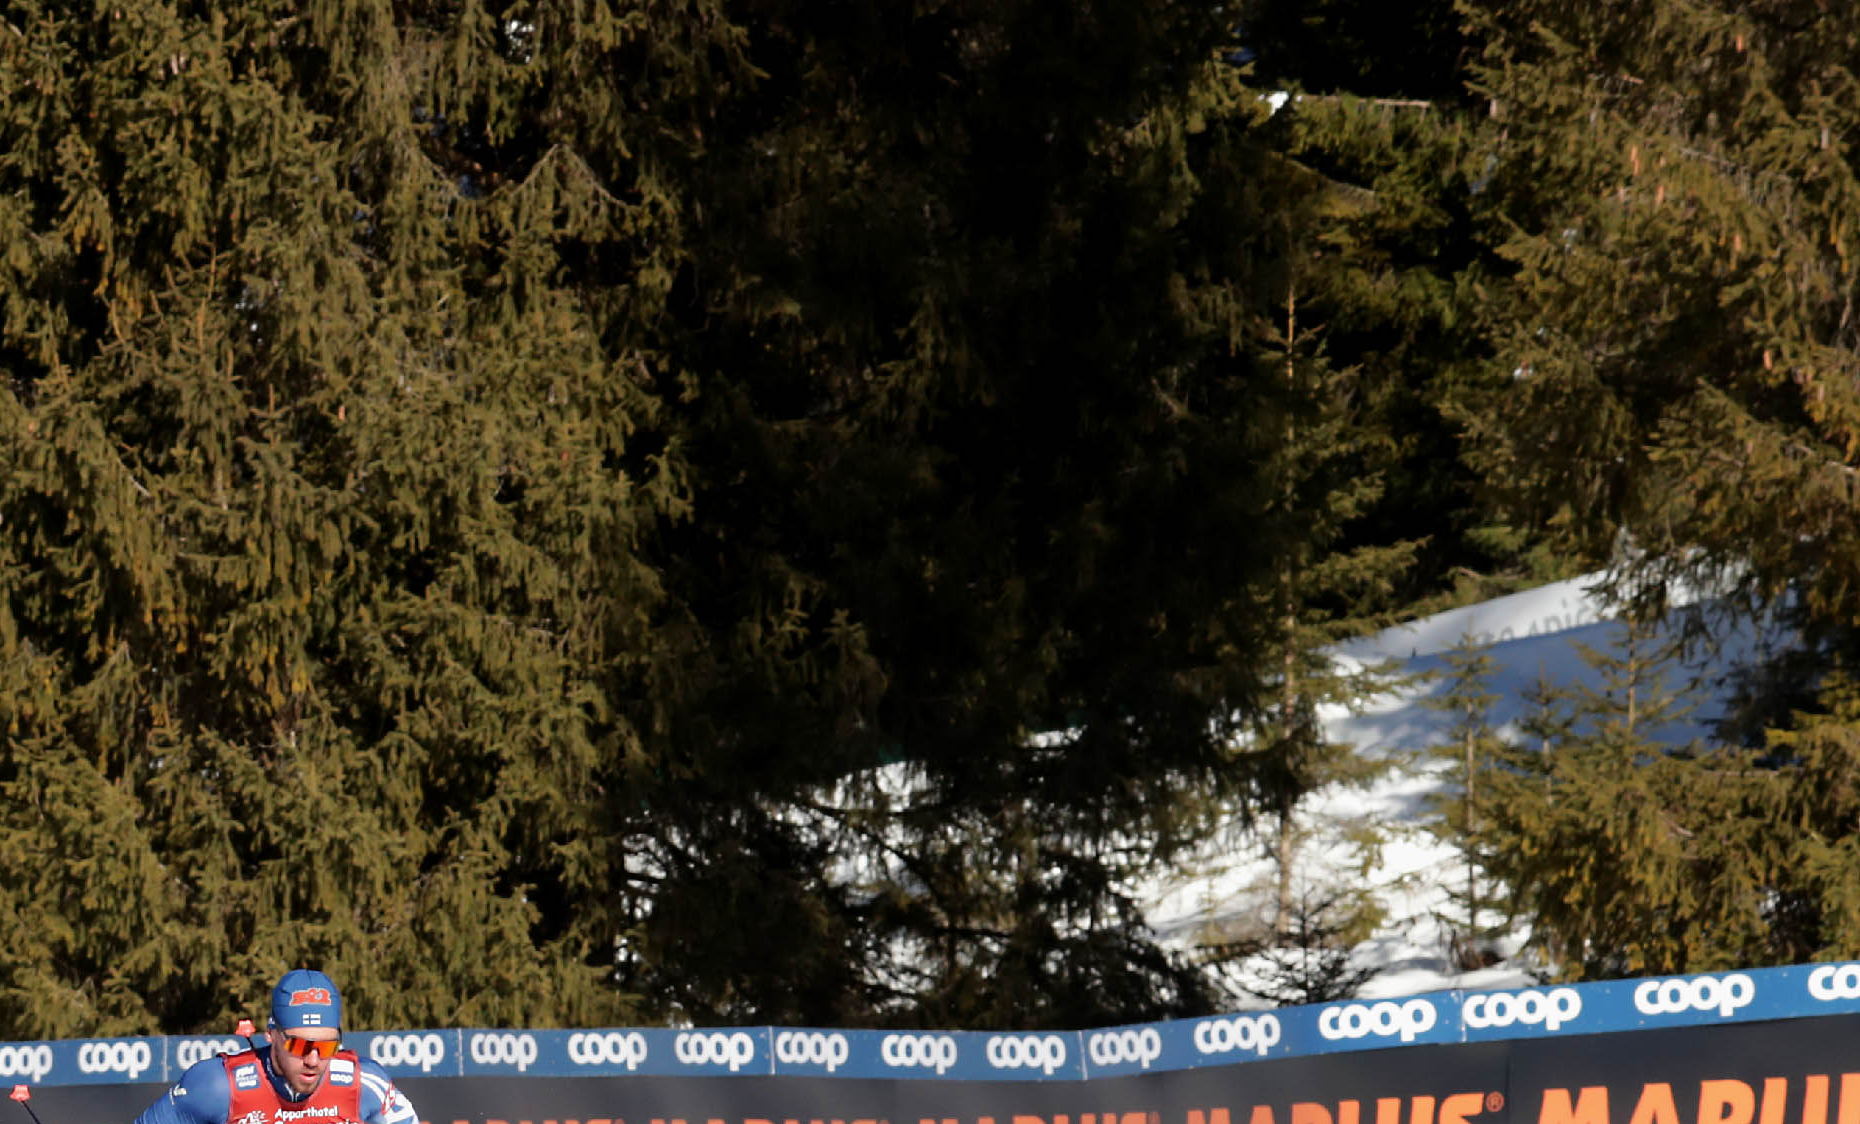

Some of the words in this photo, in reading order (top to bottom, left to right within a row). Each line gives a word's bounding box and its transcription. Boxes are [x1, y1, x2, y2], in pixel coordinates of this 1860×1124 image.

[1462, 988, 1582, 1032] coop
[1633, 973, 1756, 1018] coop
[369, 1033, 443, 1072] coop
[471, 1033, 537, 1071] coop
[568, 1032, 647, 1071] coop
[675, 1032, 754, 1071] coop
[776, 1032, 848, 1072] coop
[881, 1034, 957, 1074] coop
[987, 1034, 1066, 1074] coop
[1089, 1027, 1161, 1069] coop
[1194, 1013, 1280, 1055] coop
[1318, 998, 1436, 1042] coop
[78, 1040, 151, 1080] coop
[274, 1105, 339, 1123] Apparthotel
